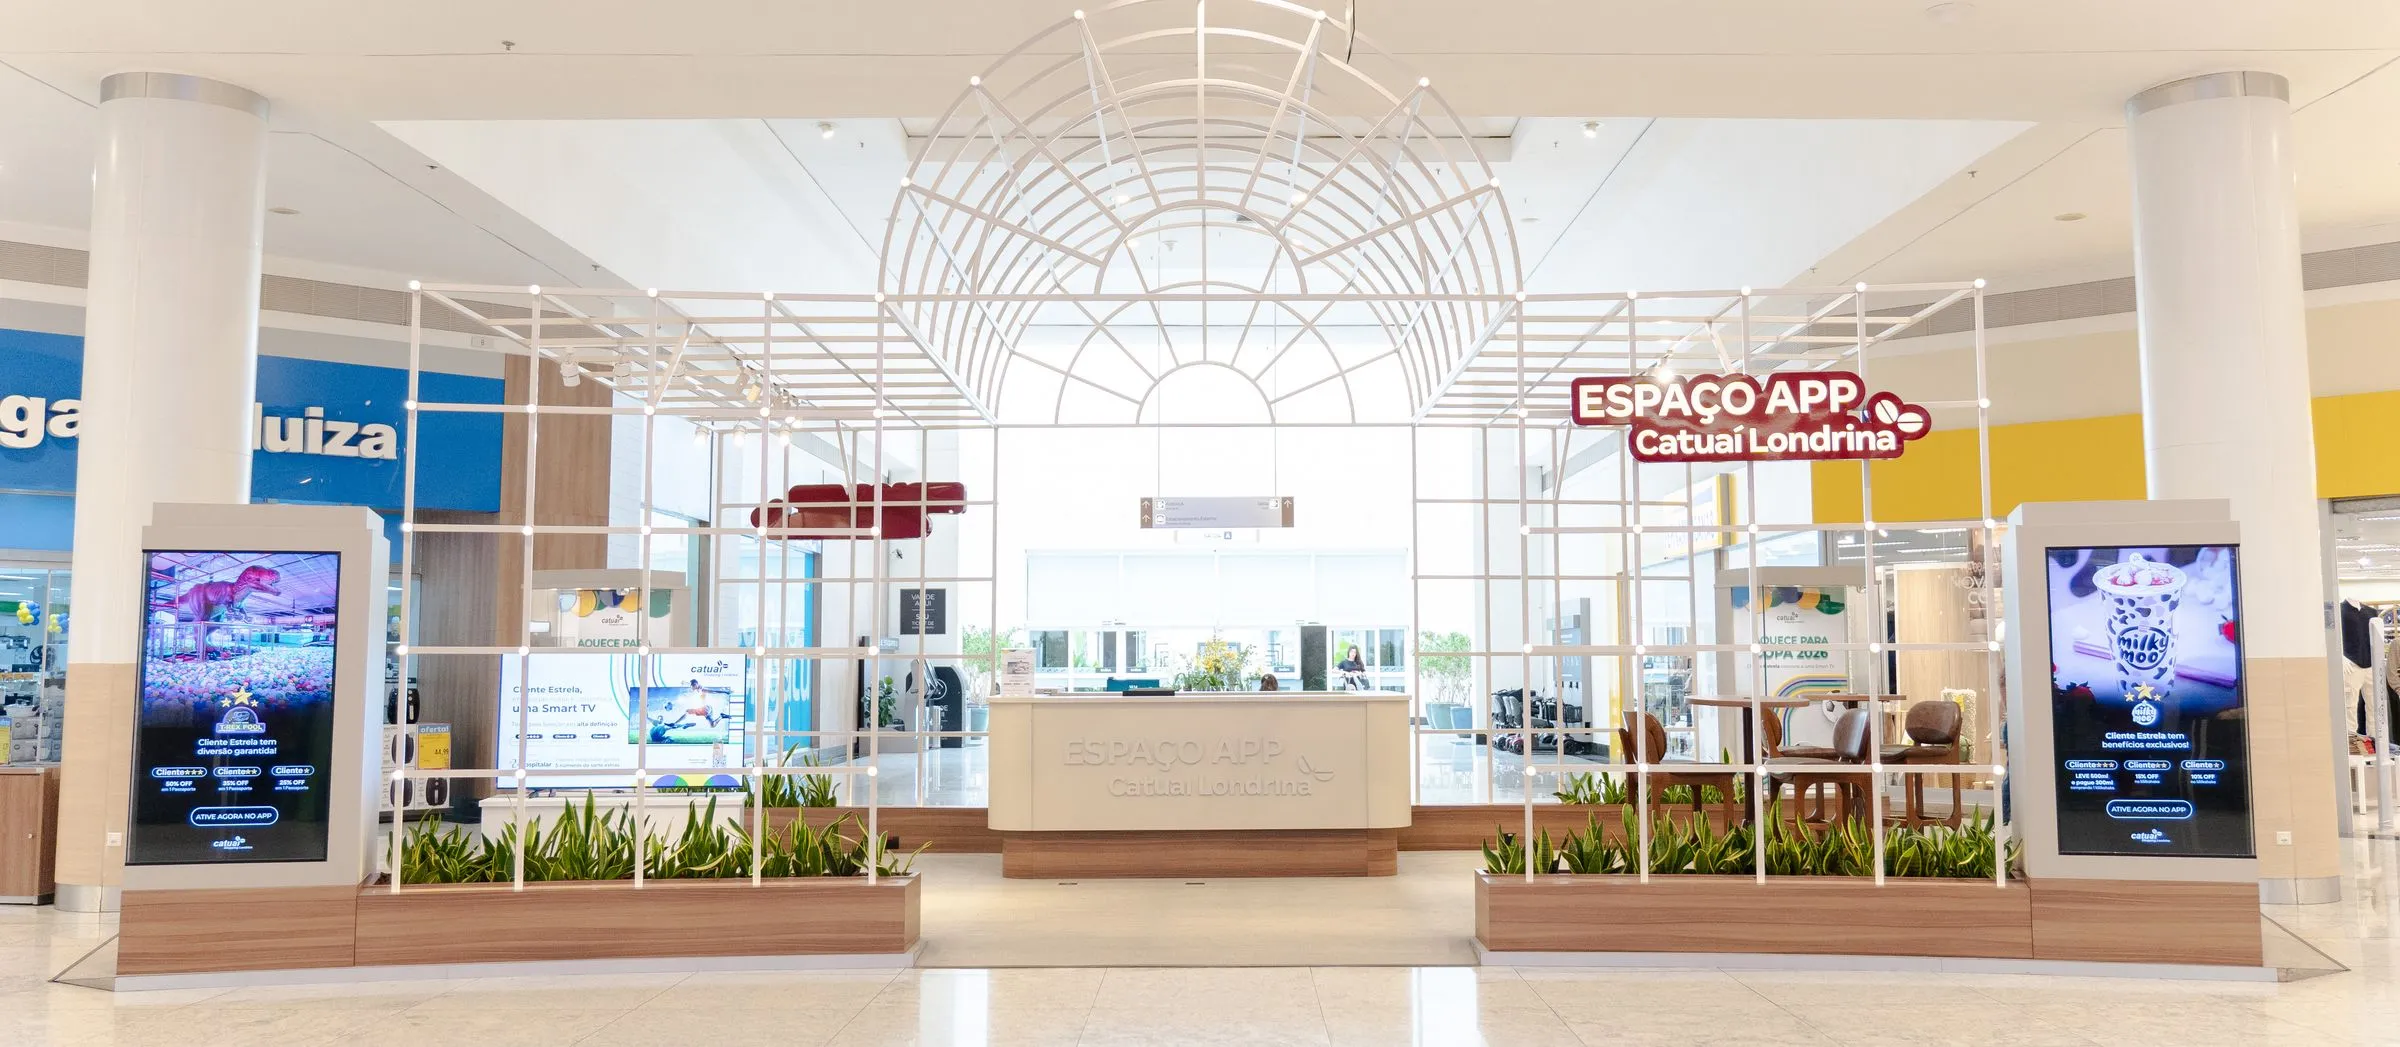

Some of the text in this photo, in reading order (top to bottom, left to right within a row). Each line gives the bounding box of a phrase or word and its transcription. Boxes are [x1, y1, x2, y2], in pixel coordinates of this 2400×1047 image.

[1578, 379, 1858, 424] ESPAÇO APP
[1636, 424, 1897, 456] Catuaí Londrina
[1800, 636, 1828, 644] PARA
[2118, 633, 2169, 653] milky
[1797, 650, 1828, 659] 2026
[2121, 649, 2159, 663] moo
[548, 686, 582, 694] Estrela,
[542, 704, 577, 713] Smart
[580, 704, 596, 713] TV
[234, 747, 277, 756] garantida!
[1064, 739, 1285, 772] ESPAÇO APP
[1199, 775, 1312, 797] Londrina
